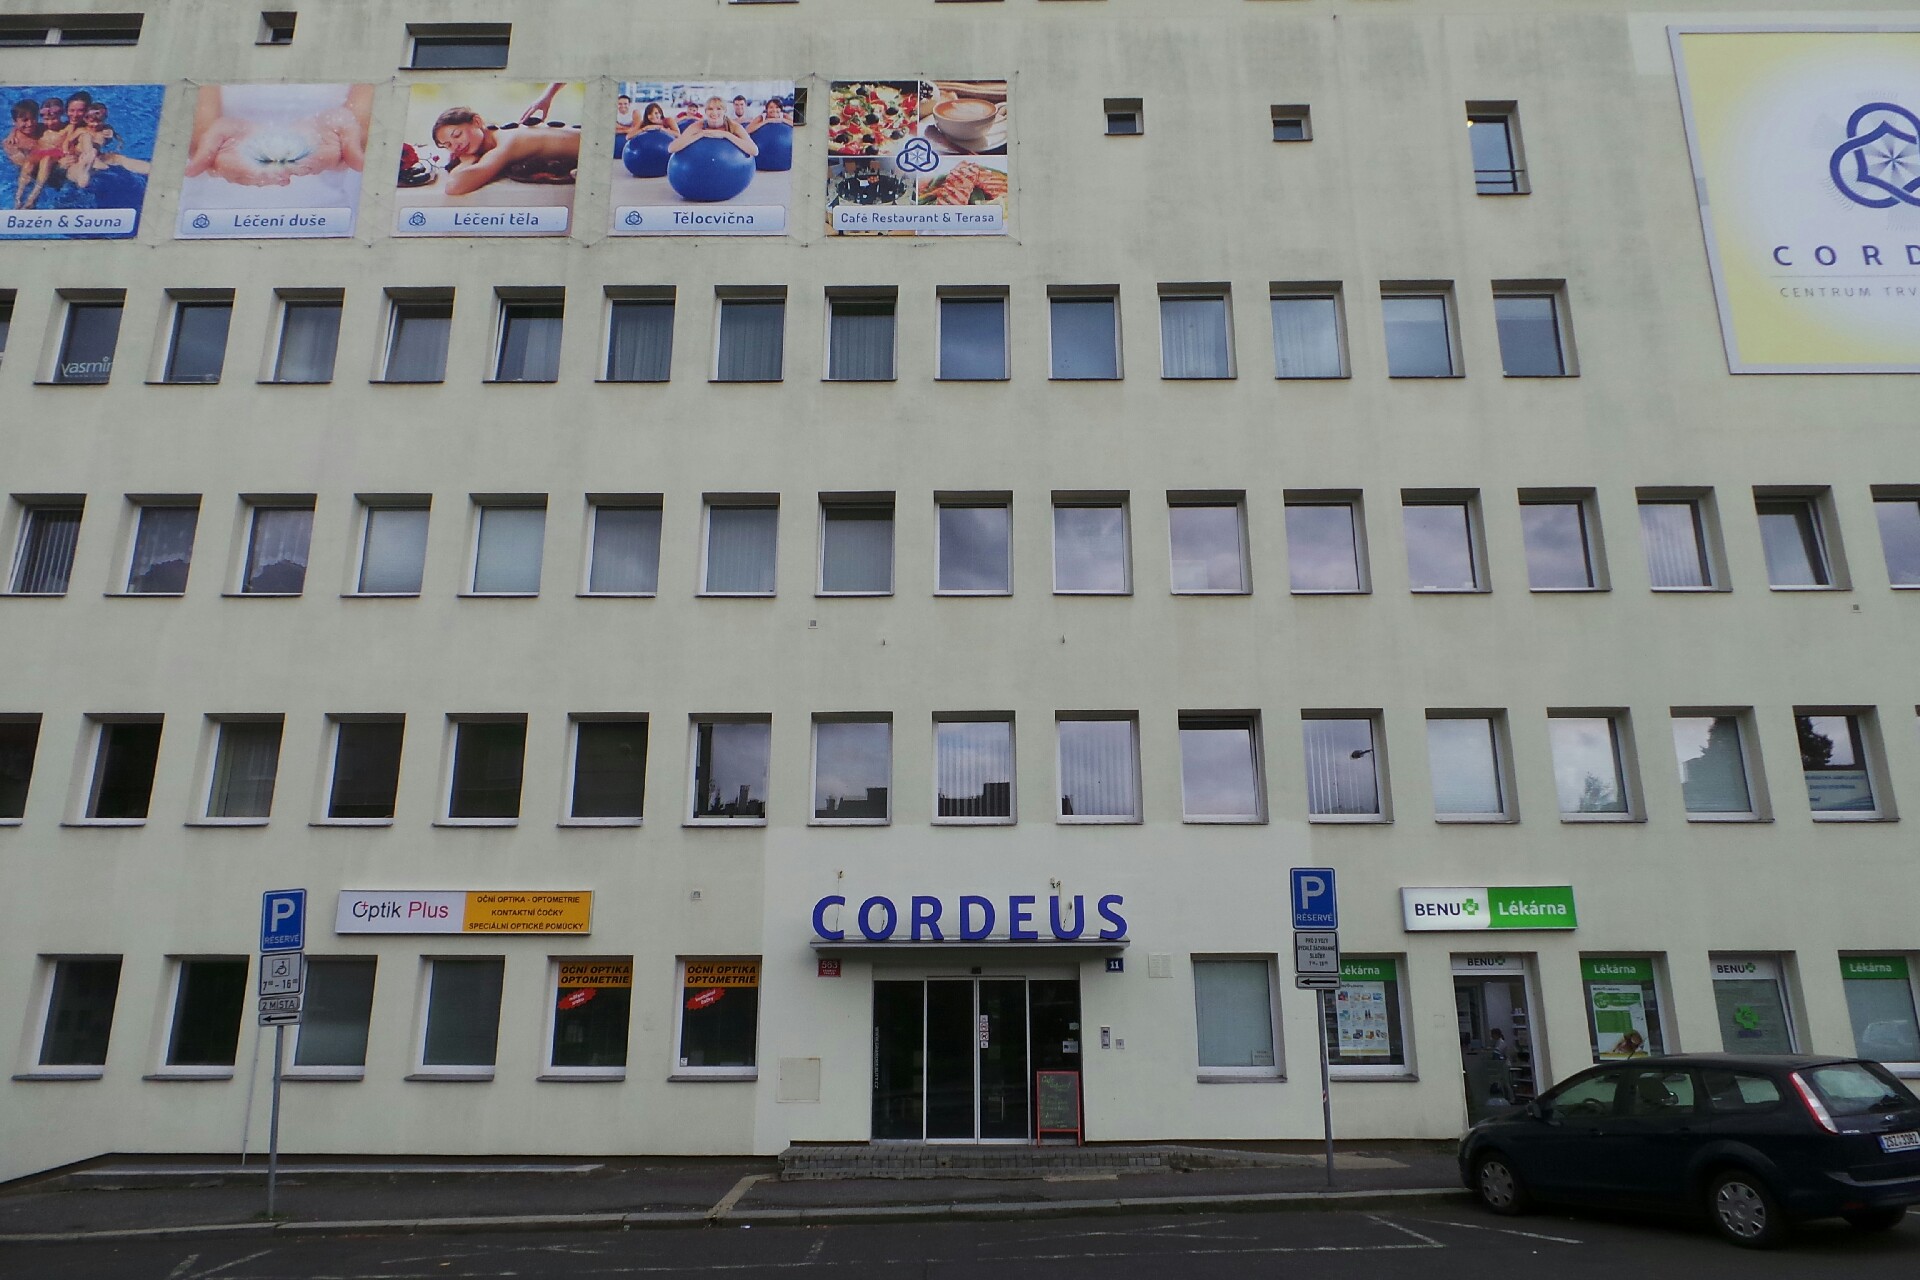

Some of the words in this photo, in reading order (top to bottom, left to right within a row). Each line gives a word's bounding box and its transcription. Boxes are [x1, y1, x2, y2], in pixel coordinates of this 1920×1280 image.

[7, 215, 52, 229] Bazén
[57, 215, 69, 228] &
[74, 215, 122, 227] Sauna
[234, 214, 284, 227] Léčení
[289, 214, 326, 226] duše
[454, 213, 504, 226] Léčení
[509, 213, 539, 226] těla
[673, 211, 754, 224] Tělocvična
[841, 212, 868, 223] Café
[872, 212, 939, 223] Restaurant
[942, 212, 951, 223] &
[955, 212, 994, 223] Terasa
[1773, 245, 1920, 266] CORD
[1780, 287, 1871, 298] CENTRUM
[1884, 286, 1917, 297] TRV
[1300, 876, 1326, 910] P
[352, 901, 402, 922] Optik
[408, 901, 449, 918] Plus
[1414, 903, 1461, 916] BENU
[1498, 900, 1567, 915] Lékárna
[270, 898, 296, 932] P
[812, 895, 1128, 941] CORDEUS
[1110, 960, 1120, 968] 11
[1468, 958, 1494, 966] BENU
[1849, 963, 1892, 972] Lékárna
[590, 966, 630, 974] OPTIKA
[1594, 965, 1636, 974] Lékárna
[1717, 965, 1745, 973] BENU
[262, 1002, 267, 1010] 2
